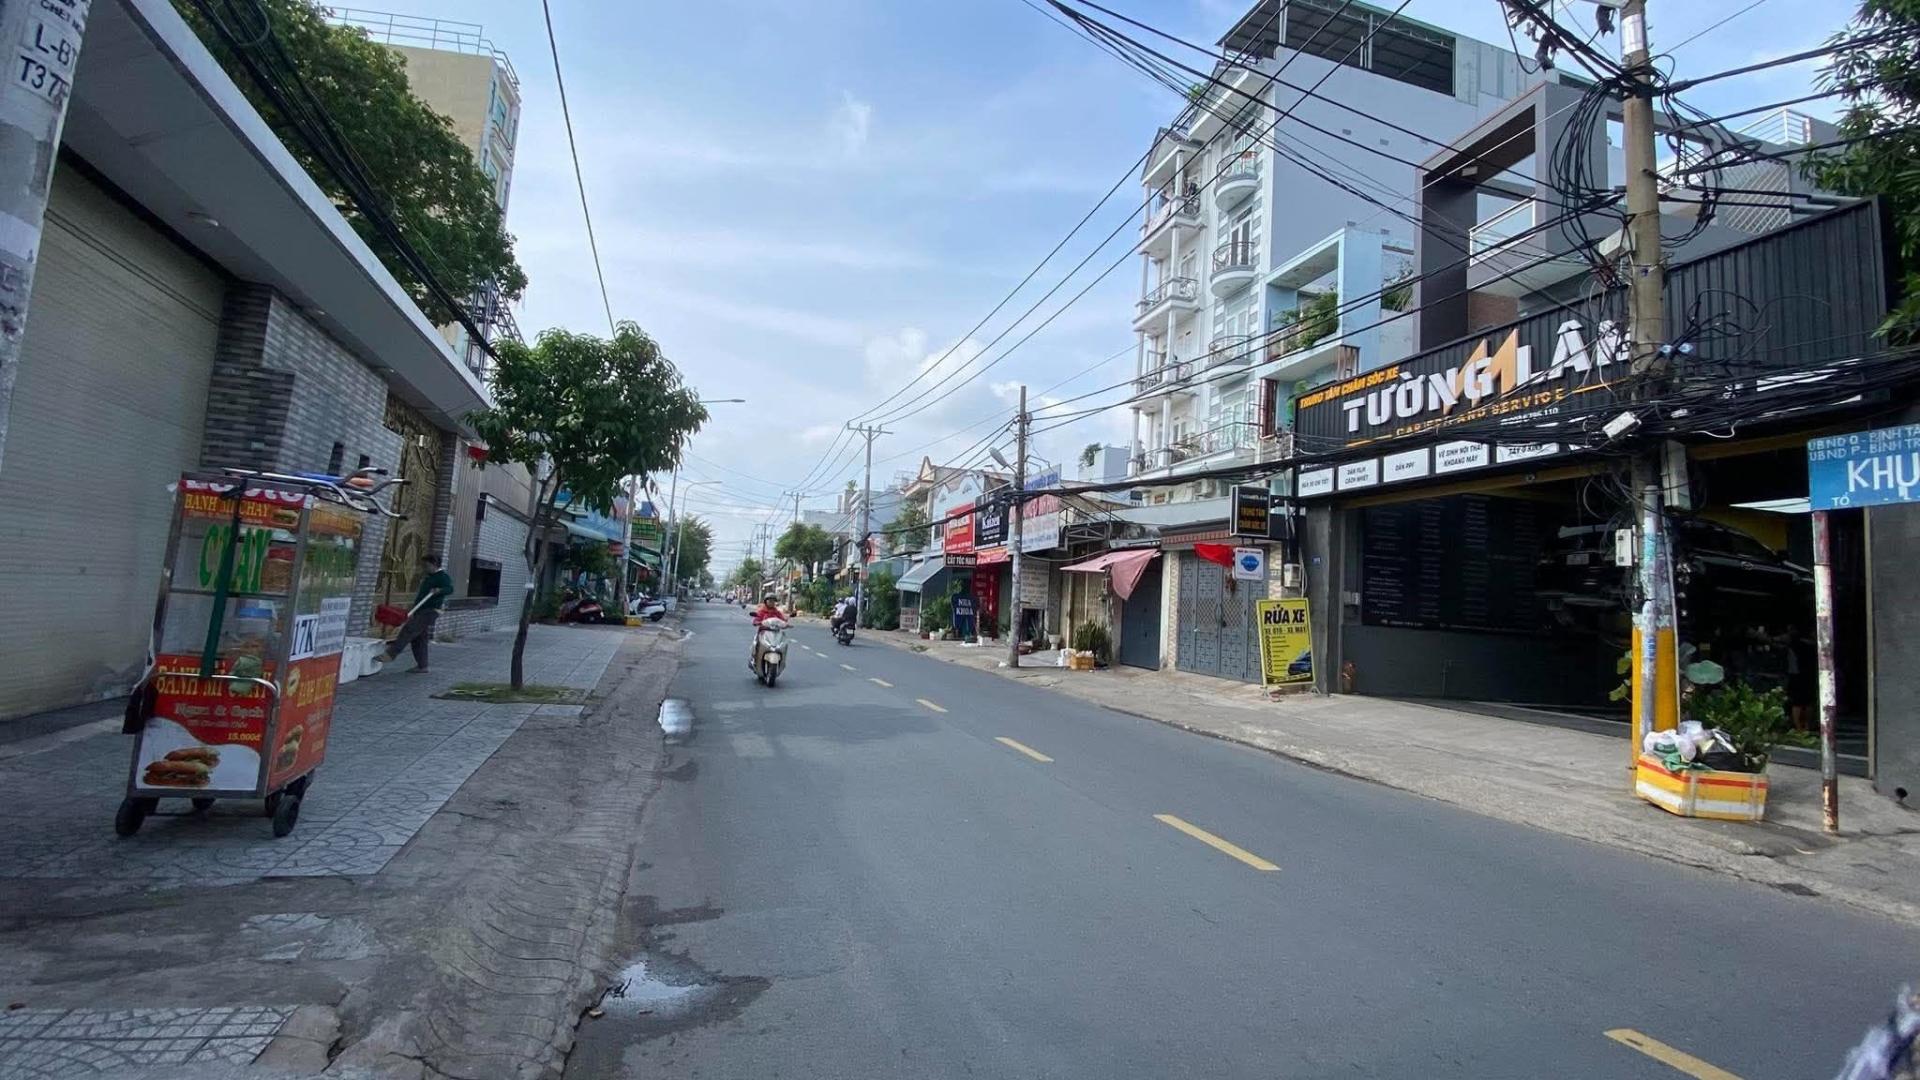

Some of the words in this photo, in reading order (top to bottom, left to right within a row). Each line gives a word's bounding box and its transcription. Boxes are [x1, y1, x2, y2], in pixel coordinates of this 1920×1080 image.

[1366, 370, 1385, 386] SÓC
[1385, 366, 1400, 382] XE
[1343, 357, 1496, 433] TƯỜNG
[1491, 388, 1566, 415] SERVICE
[1808, 438, 1846, 450] UBND
[1809, 448, 1847, 461] UBND
[1851, 446, 1860, 455] P
[956, 607, 974, 616] KHOA
[1264, 604, 1290, 625] RỬA
[1292, 609, 1305, 624] XE
[292, 619, 317, 656] 17K
